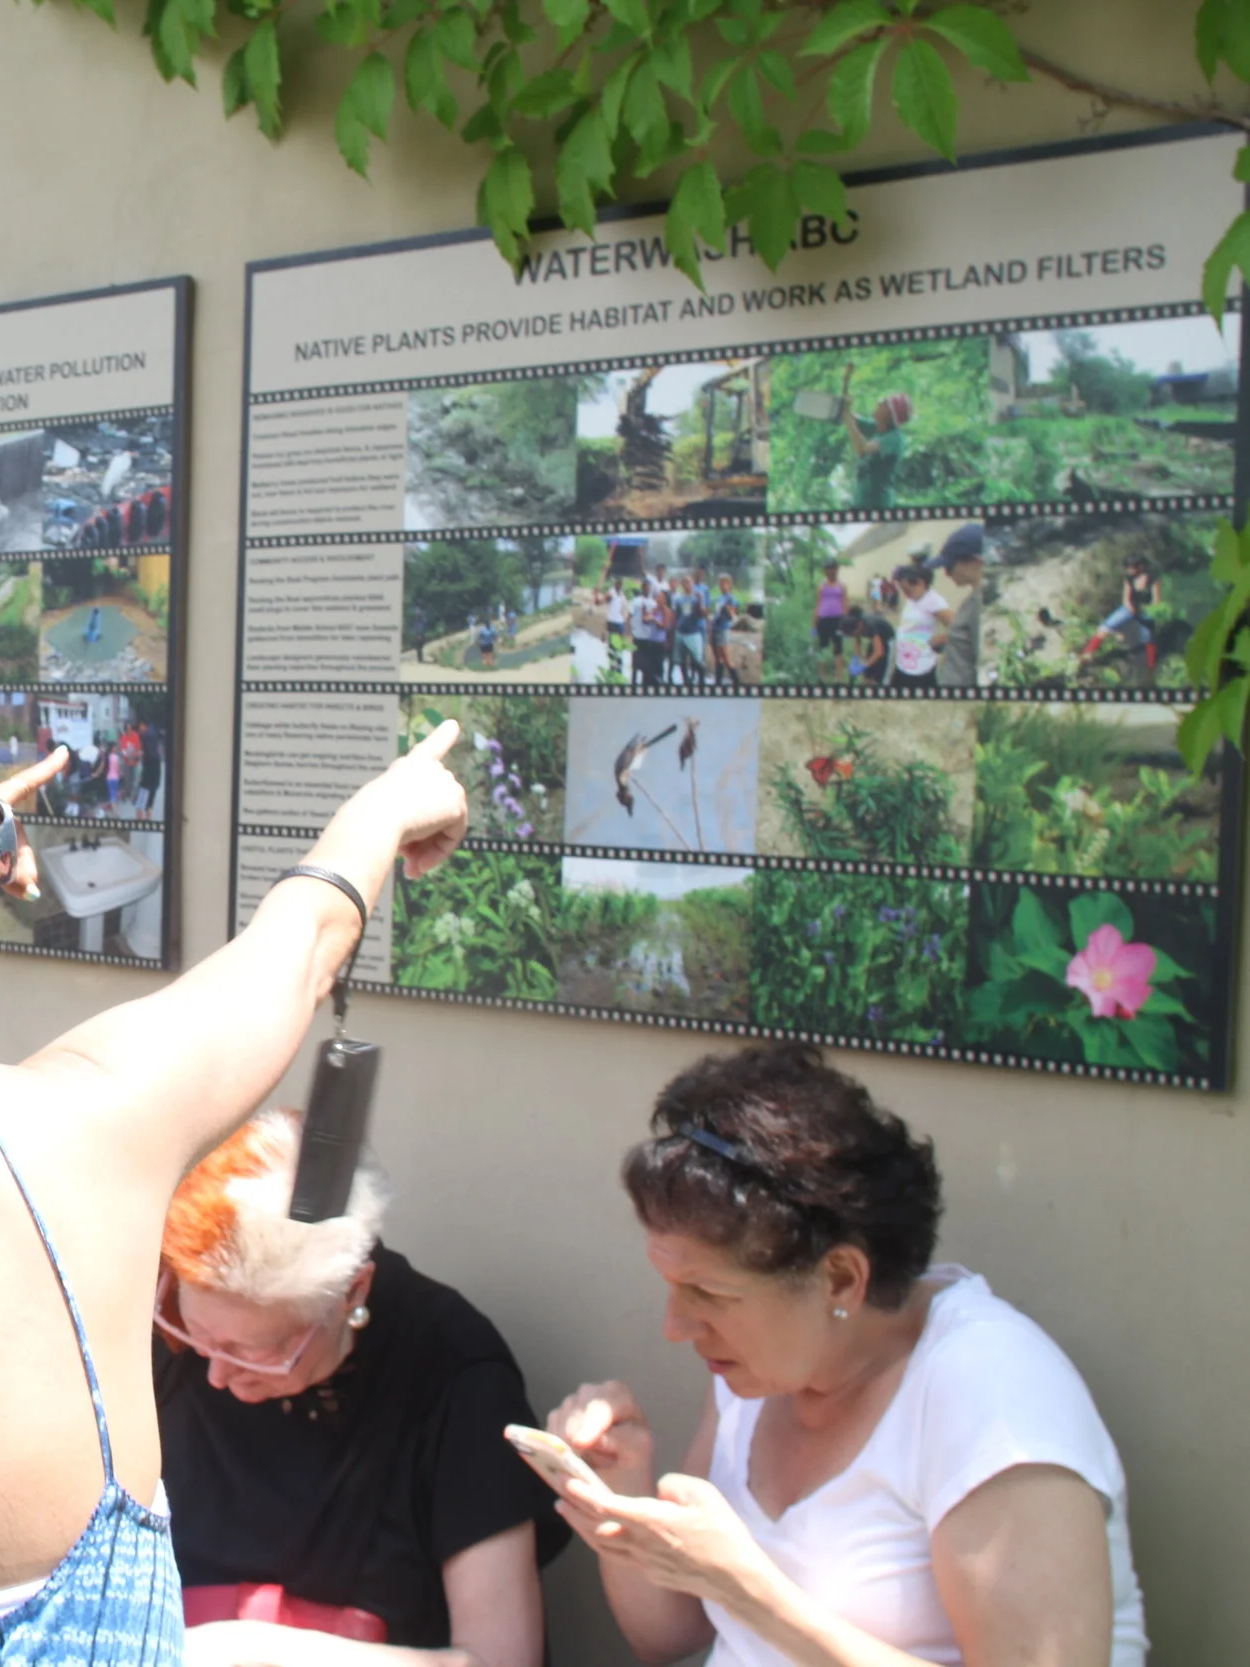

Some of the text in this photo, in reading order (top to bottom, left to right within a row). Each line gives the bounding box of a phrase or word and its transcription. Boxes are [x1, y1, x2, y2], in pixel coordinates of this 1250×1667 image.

[515, 209, 859, 287] WATERWH BC
[295, 244, 1167, 361] NATIVE PLANTS PROVIDE HABITAT AND WORK AS WETLAND FILTERS
[49, 351, 147, 380] POLLUTION
